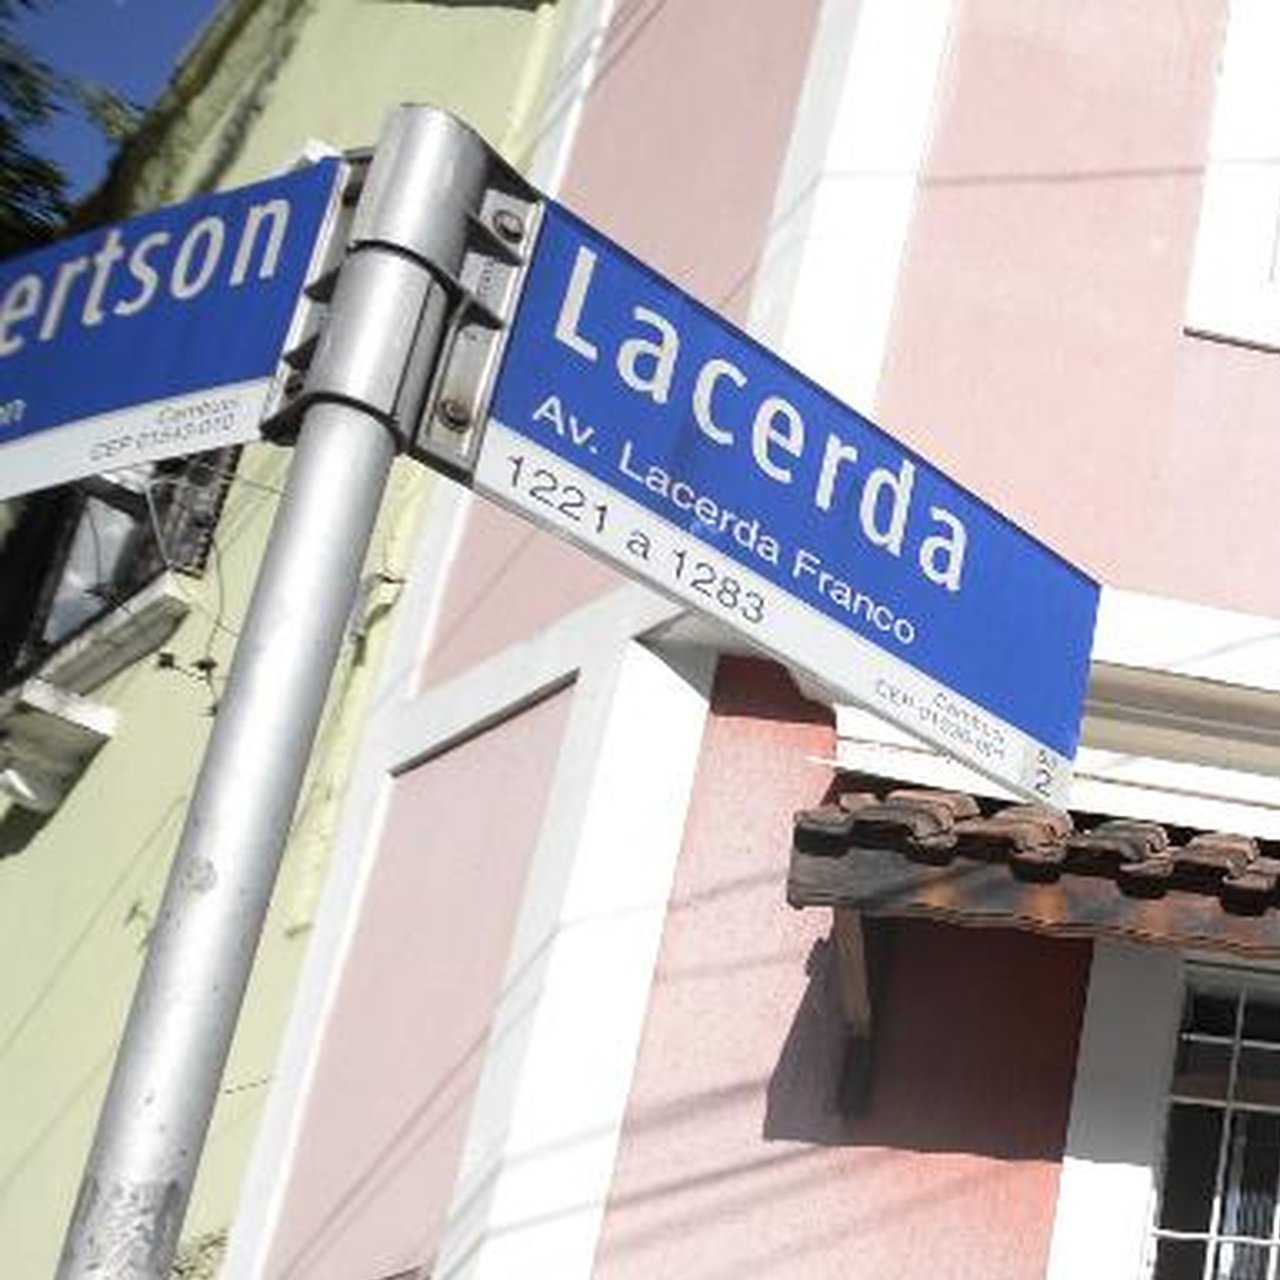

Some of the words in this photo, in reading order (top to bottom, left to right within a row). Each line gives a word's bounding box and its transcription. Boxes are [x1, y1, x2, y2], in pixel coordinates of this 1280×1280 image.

[0, 198, 291, 356] ertson
[532, 395, 598, 455] Av.
[618, 440, 780, 566] Lacerda
[793, 549, 916, 645] Franco
[554, 244, 970, 593] Lacerda
[508, 454, 607, 534] 1221
[625, 529, 652, 560] a
[672, 547, 766, 625] 1283
